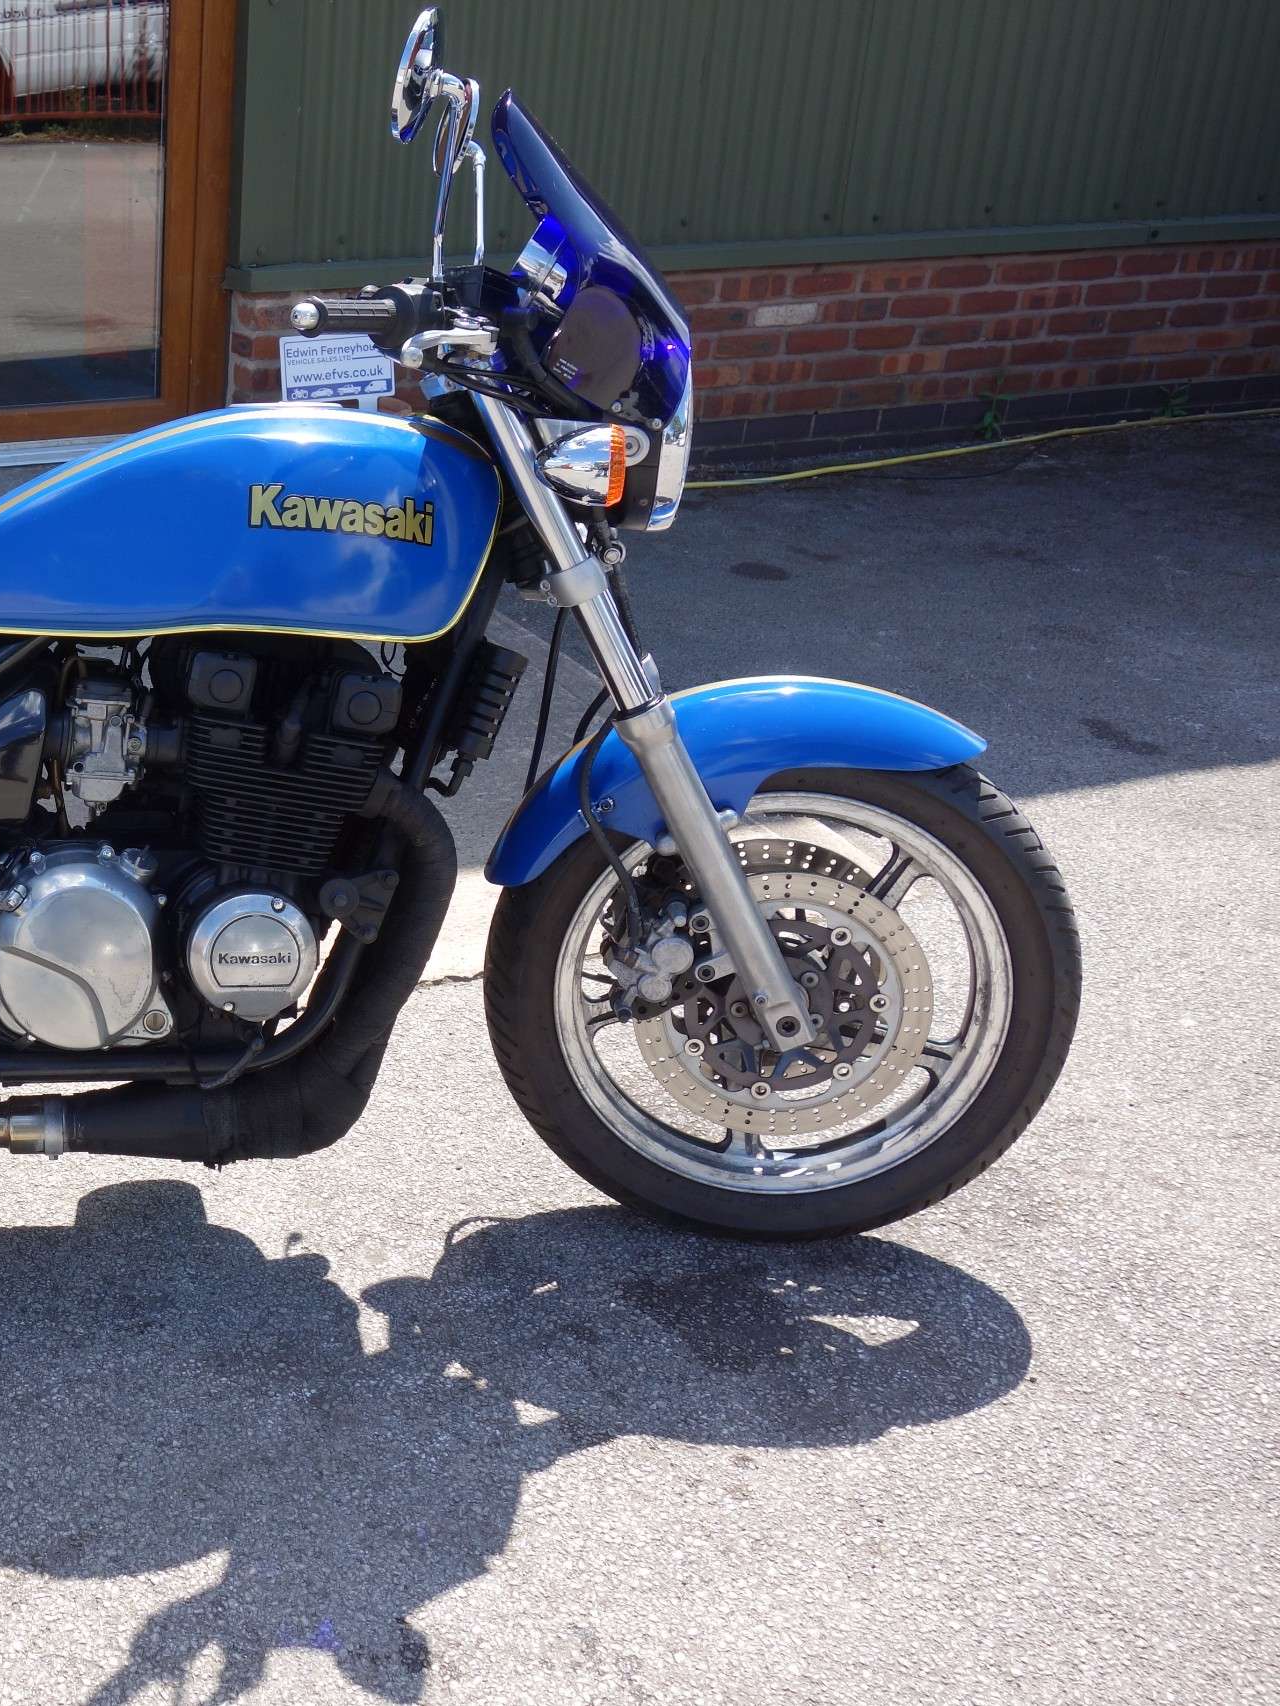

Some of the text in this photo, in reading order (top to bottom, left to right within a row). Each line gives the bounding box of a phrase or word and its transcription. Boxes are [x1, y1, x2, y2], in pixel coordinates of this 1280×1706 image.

[286, 345, 318, 359] Edwin
[287, 358, 315, 366] VEHICLE
[293, 365, 384, 383] www.efvs.co.uk
[249, 483, 434, 546] Kawasaki
[218, 952, 291, 964] Kawasaki
